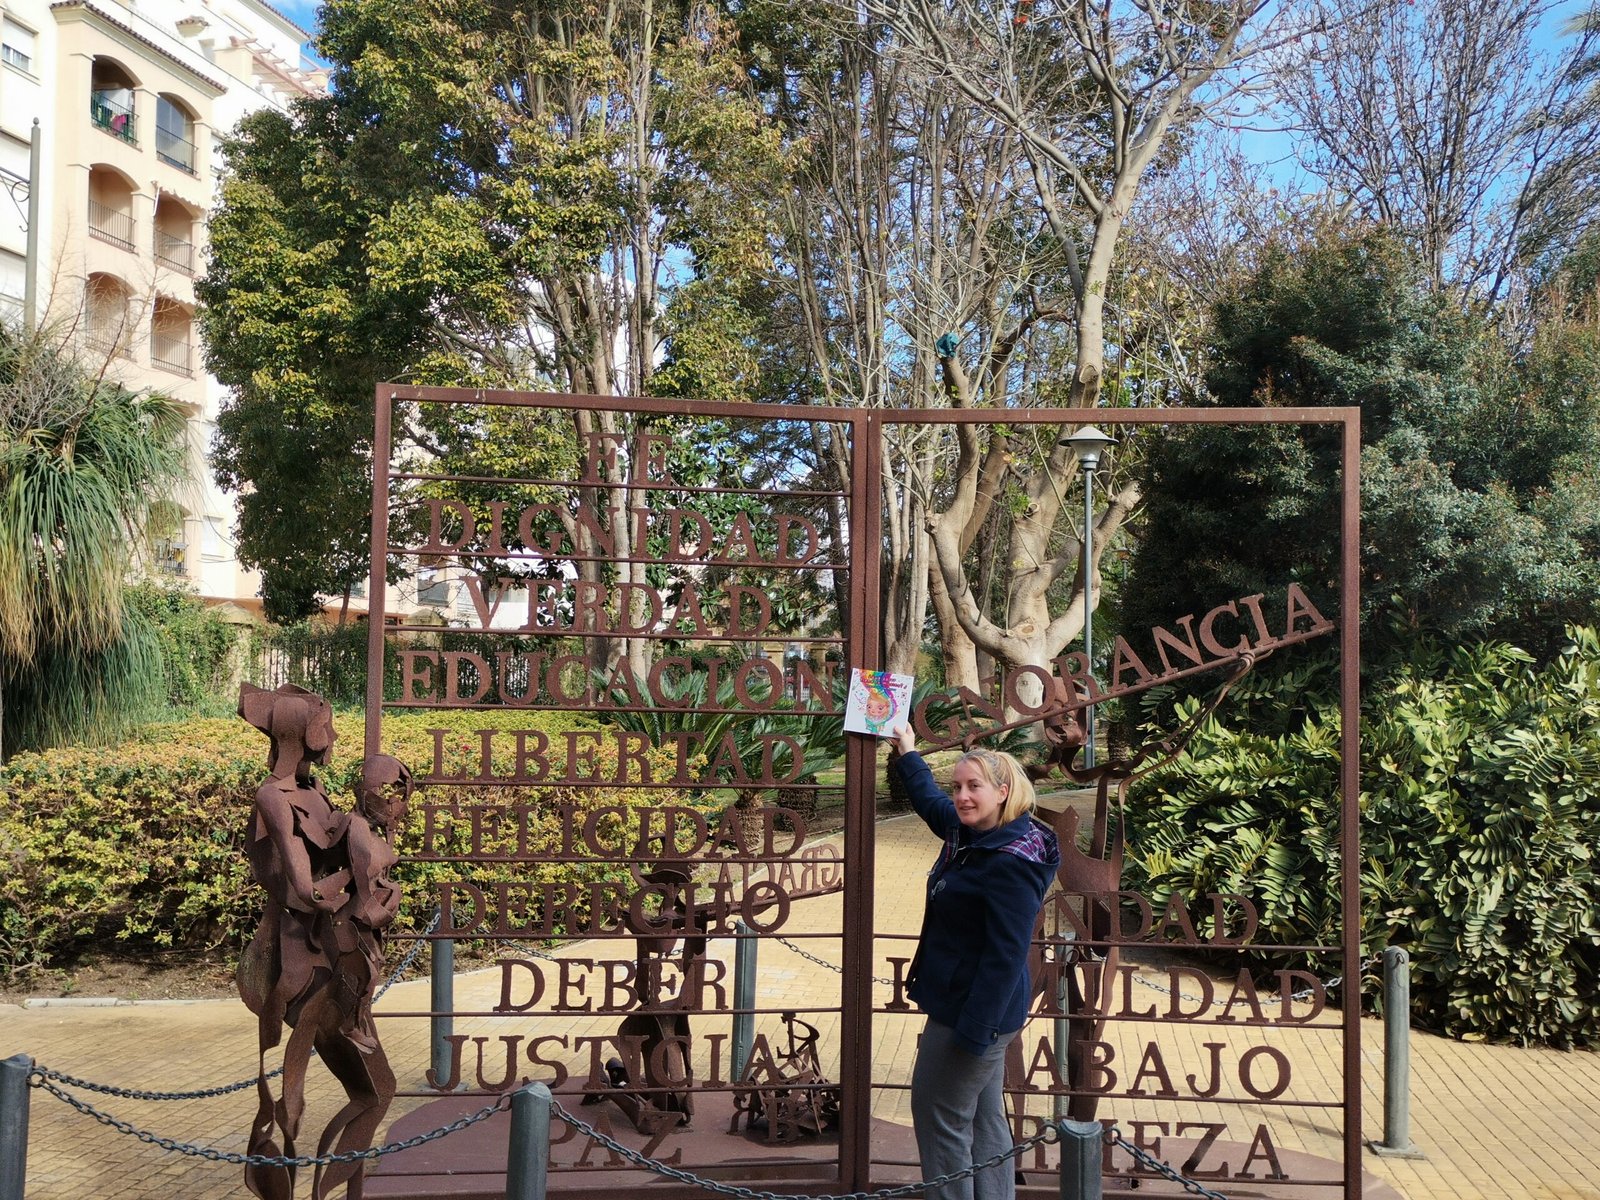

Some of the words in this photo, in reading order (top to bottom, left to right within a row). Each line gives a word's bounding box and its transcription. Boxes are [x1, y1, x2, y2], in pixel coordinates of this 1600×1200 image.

[583, 432, 672, 486] FE
[424, 500, 818, 563] DIGNIDAD
[460, 575, 769, 637] VERDAD
[401, 650, 838, 711] EDUCACION
[914, 582, 1333, 745] GNORANCIA
[424, 728, 802, 785] LIBERTAD
[417, 804, 806, 858] FELICIDAD
[432, 880, 791, 935] DERECHO
[493, 958, 729, 1013] DEBER
[425, 1033, 787, 1092] JUSTICIA
